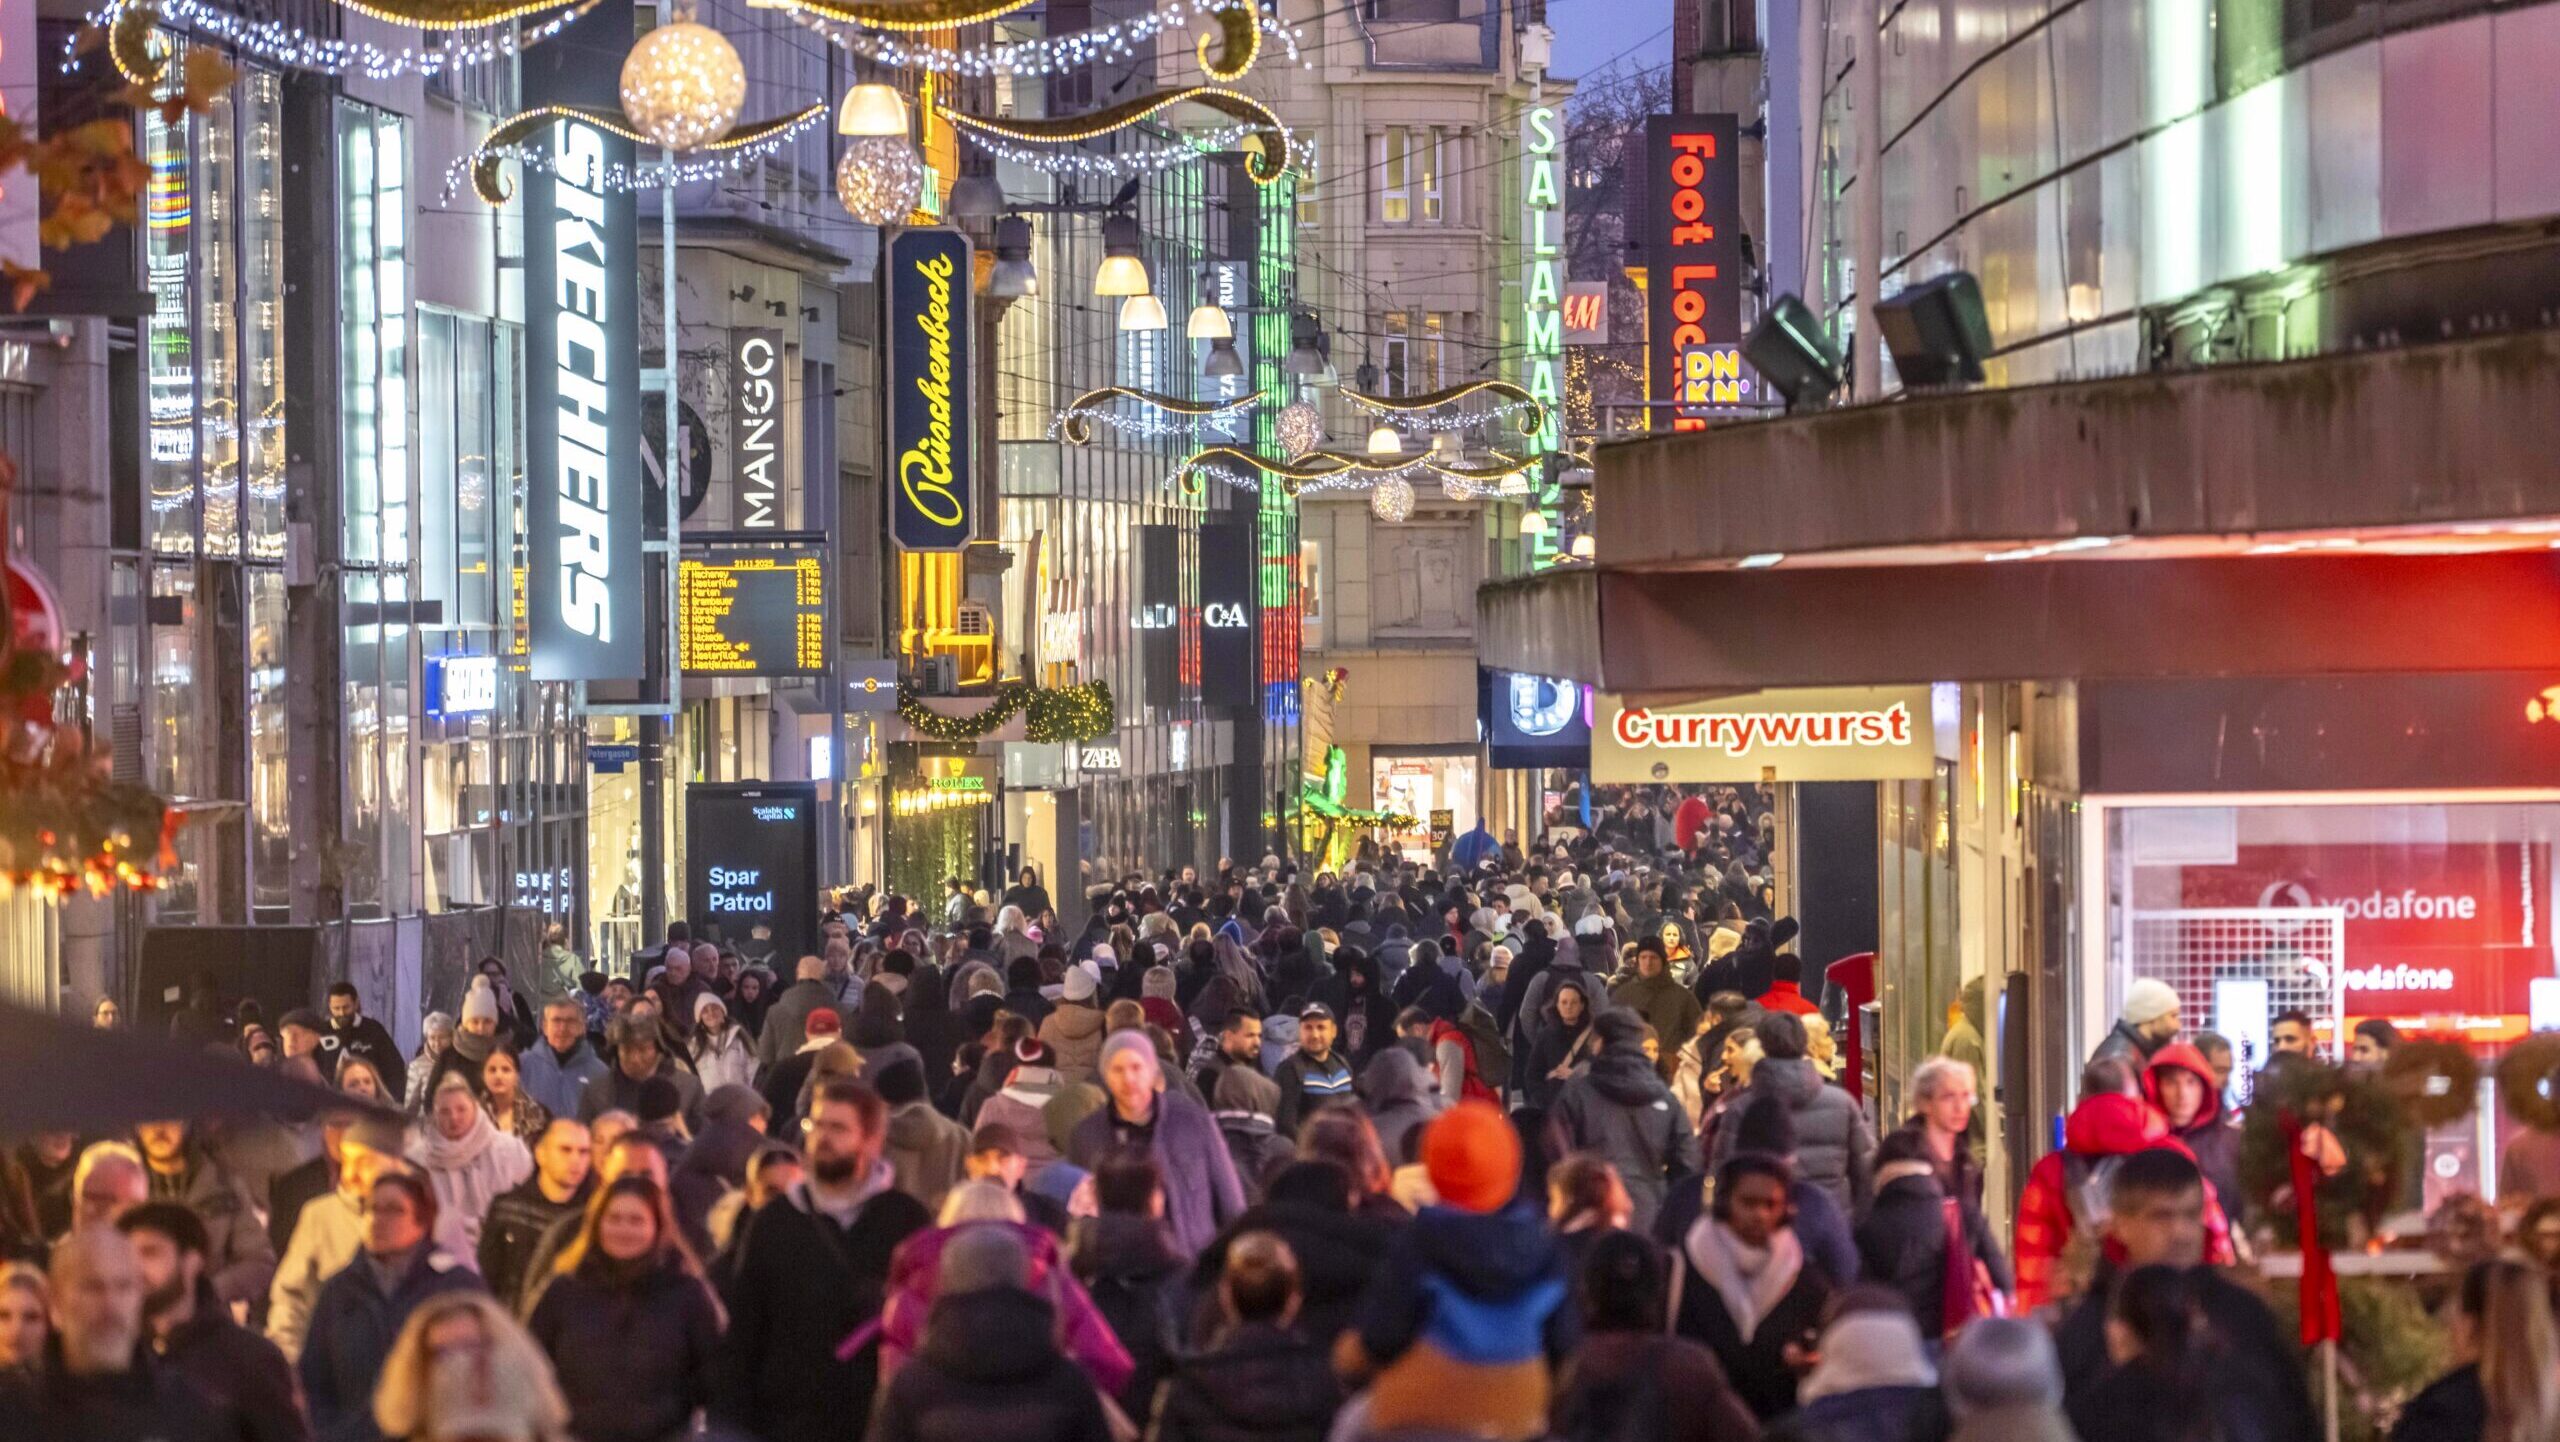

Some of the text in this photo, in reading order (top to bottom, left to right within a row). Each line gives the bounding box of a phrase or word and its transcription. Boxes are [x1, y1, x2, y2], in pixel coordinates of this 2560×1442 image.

[1671, 133, 1716, 246] Foot
[1524, 107, 1560, 571] SALAMANDE
[1686, 350, 1740, 380] DN
[555, 117, 610, 644] SKECHERS
[900, 252, 963, 527] Rüschenbeck
[741, 338, 775, 527] MANGO
[692, 570, 728, 578] Hacheney
[692, 588, 720, 596] Marten
[692, 597, 733, 606] Brambauer
[1205, 603, 1248, 628] C&A
[1614, 702, 1911, 756] Currywurst
[931, 777, 984, 790] ROLEX
[753, 806, 783, 815] Scalable
[758, 813, 783, 821] Capital
[709, 867, 759, 890] Spar
[709, 891, 773, 911] Patrol
